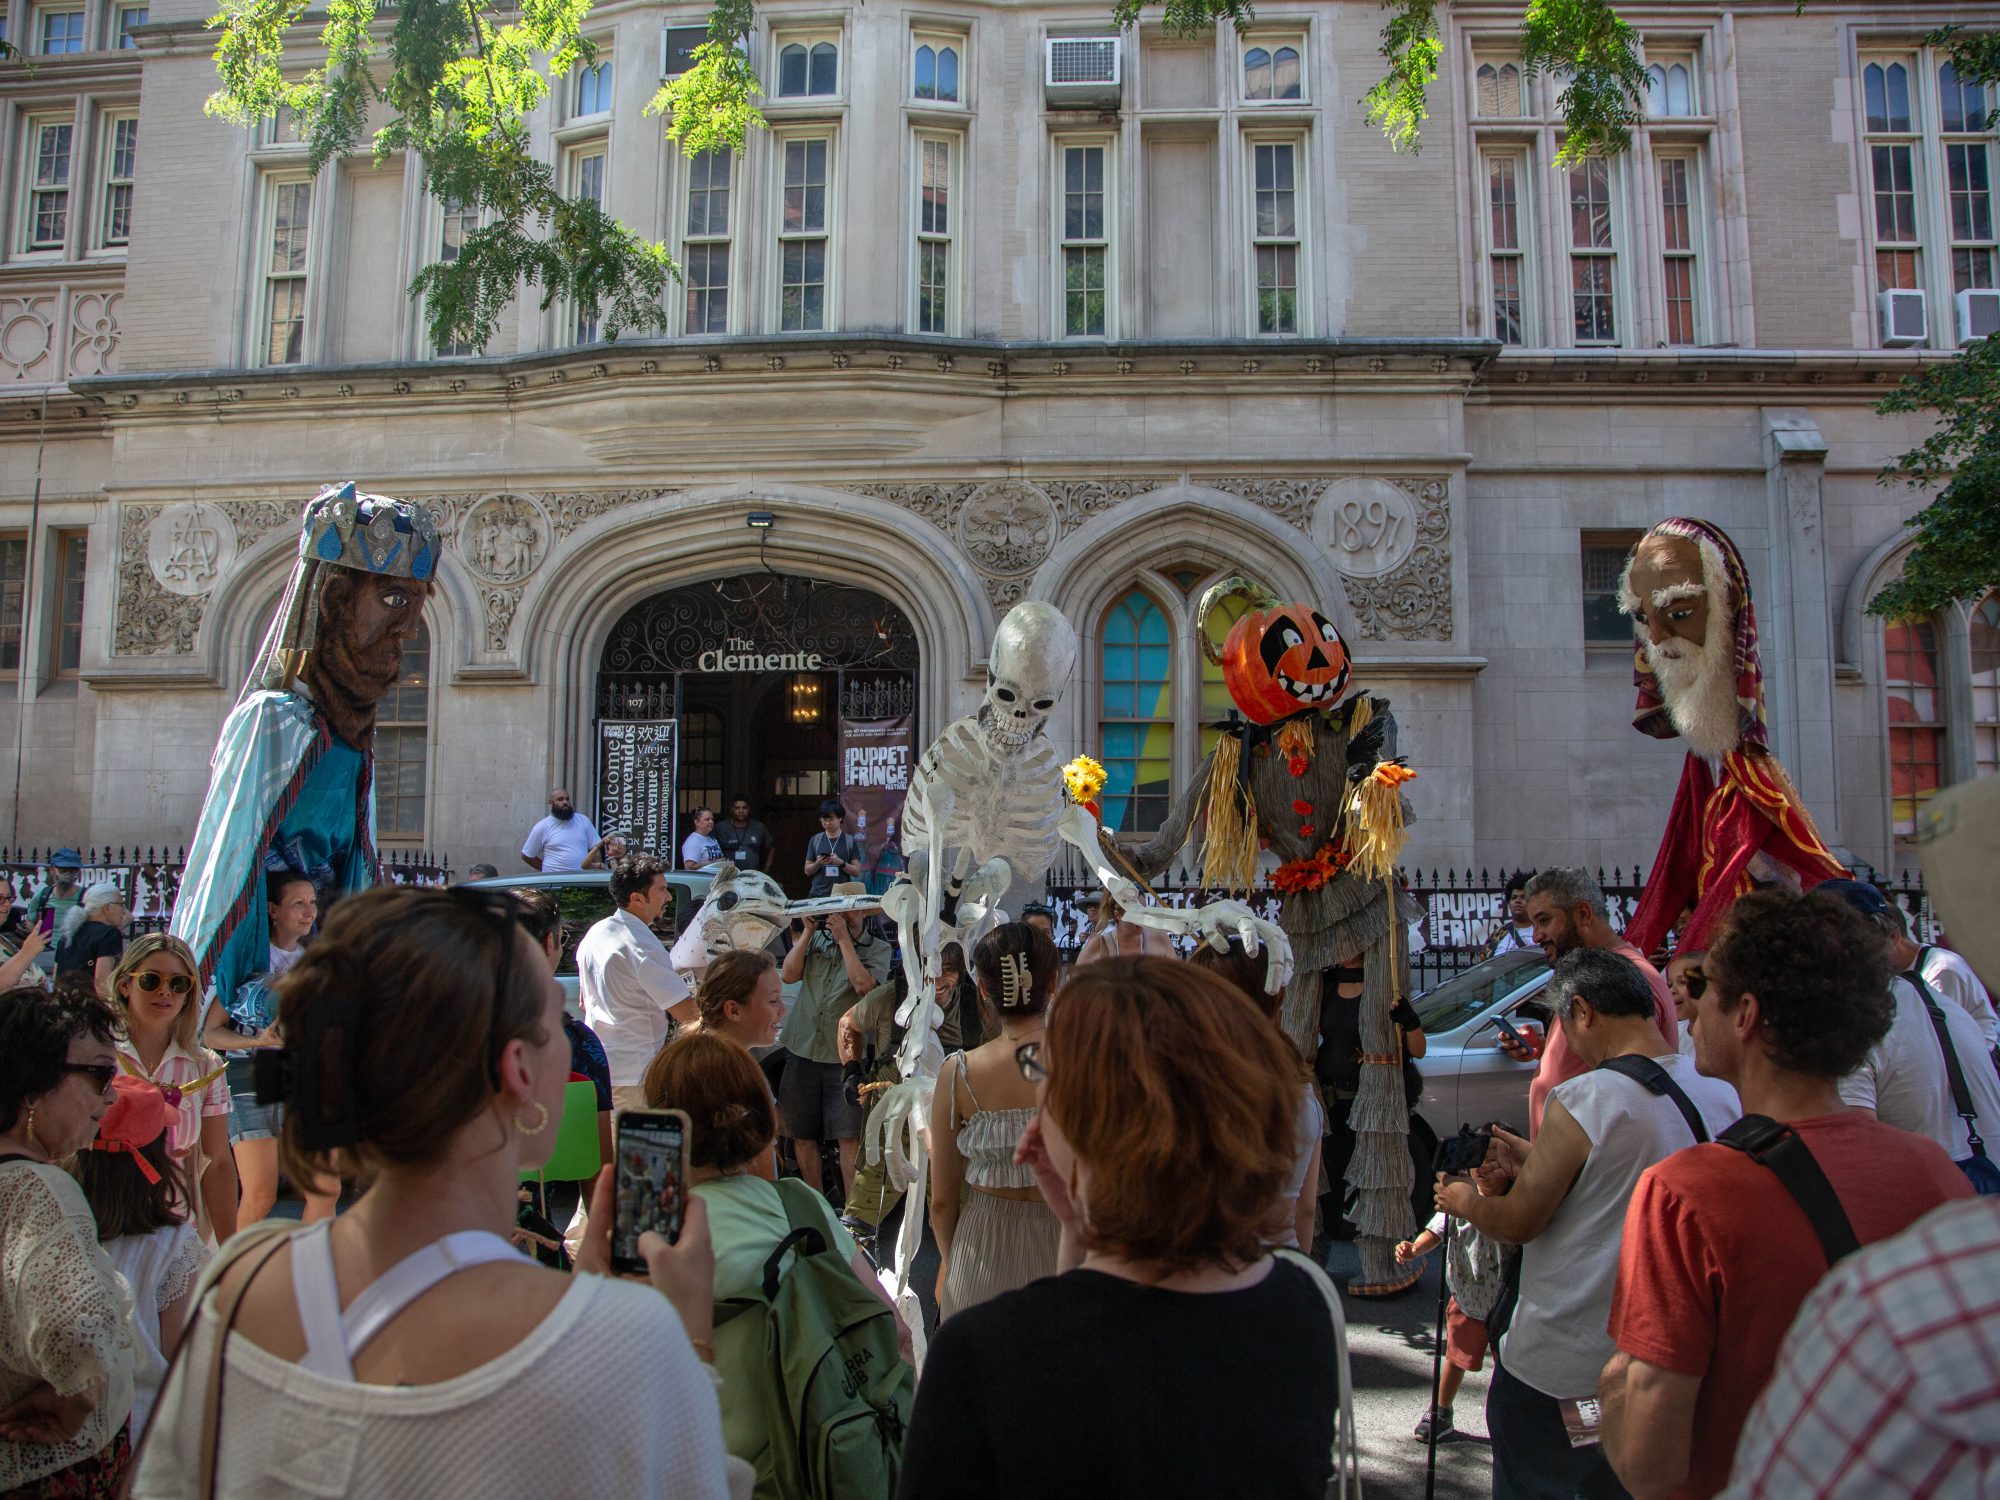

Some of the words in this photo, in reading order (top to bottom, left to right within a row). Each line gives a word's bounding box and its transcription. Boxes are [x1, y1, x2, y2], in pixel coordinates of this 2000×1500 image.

[1329, 502, 1403, 551] 1897
[727, 637, 754, 651] The
[698, 649, 822, 672] Clemente
[628, 699, 643, 708] 107
[637, 725, 670, 741] 欢迎
[635, 757, 669, 768] ようこそ
[851, 745, 908, 766] PUPPET
[602, 740, 620, 837] Welcome
[618, 725, 635, 834] Bienvenidos
[634, 770, 645, 799] vinda
[850, 765, 907, 787] FRINGE
[634, 801, 645, 826] Bem
[643, 769, 658, 849] Bienvenue
[660, 769, 670, 833] пожаловать
[658, 835, 670, 862] обро
